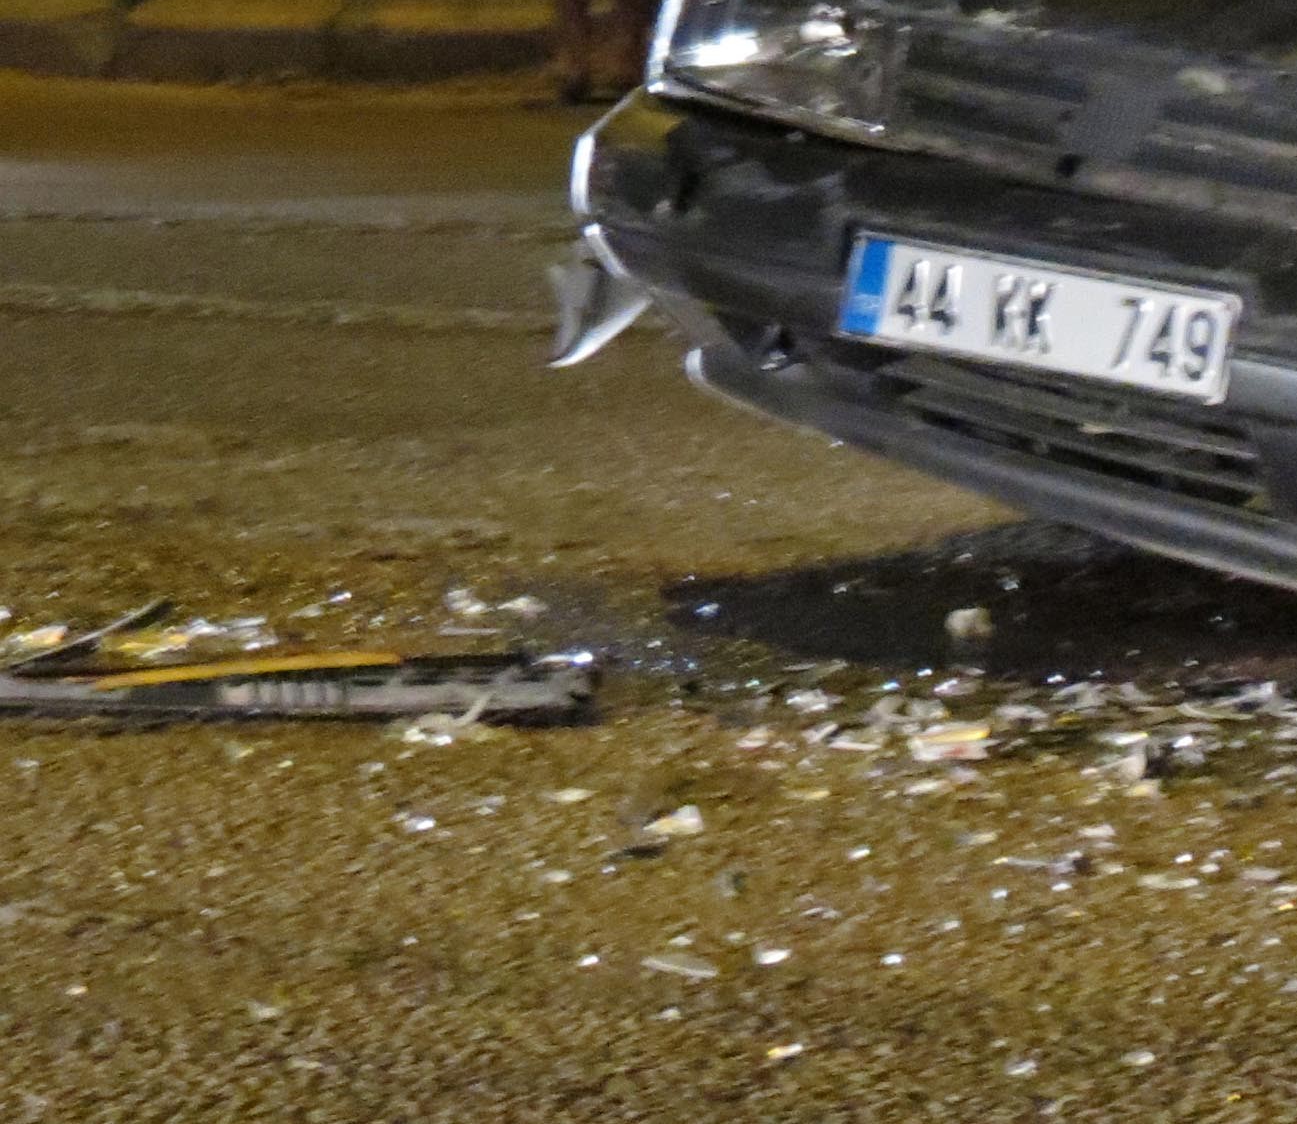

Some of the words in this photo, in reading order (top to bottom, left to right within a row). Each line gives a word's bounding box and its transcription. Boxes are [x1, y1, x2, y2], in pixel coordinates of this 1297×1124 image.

[897, 259, 963, 336] 44
[990, 274, 1057, 355] KK
[1111, 296, 1216, 380] 749
